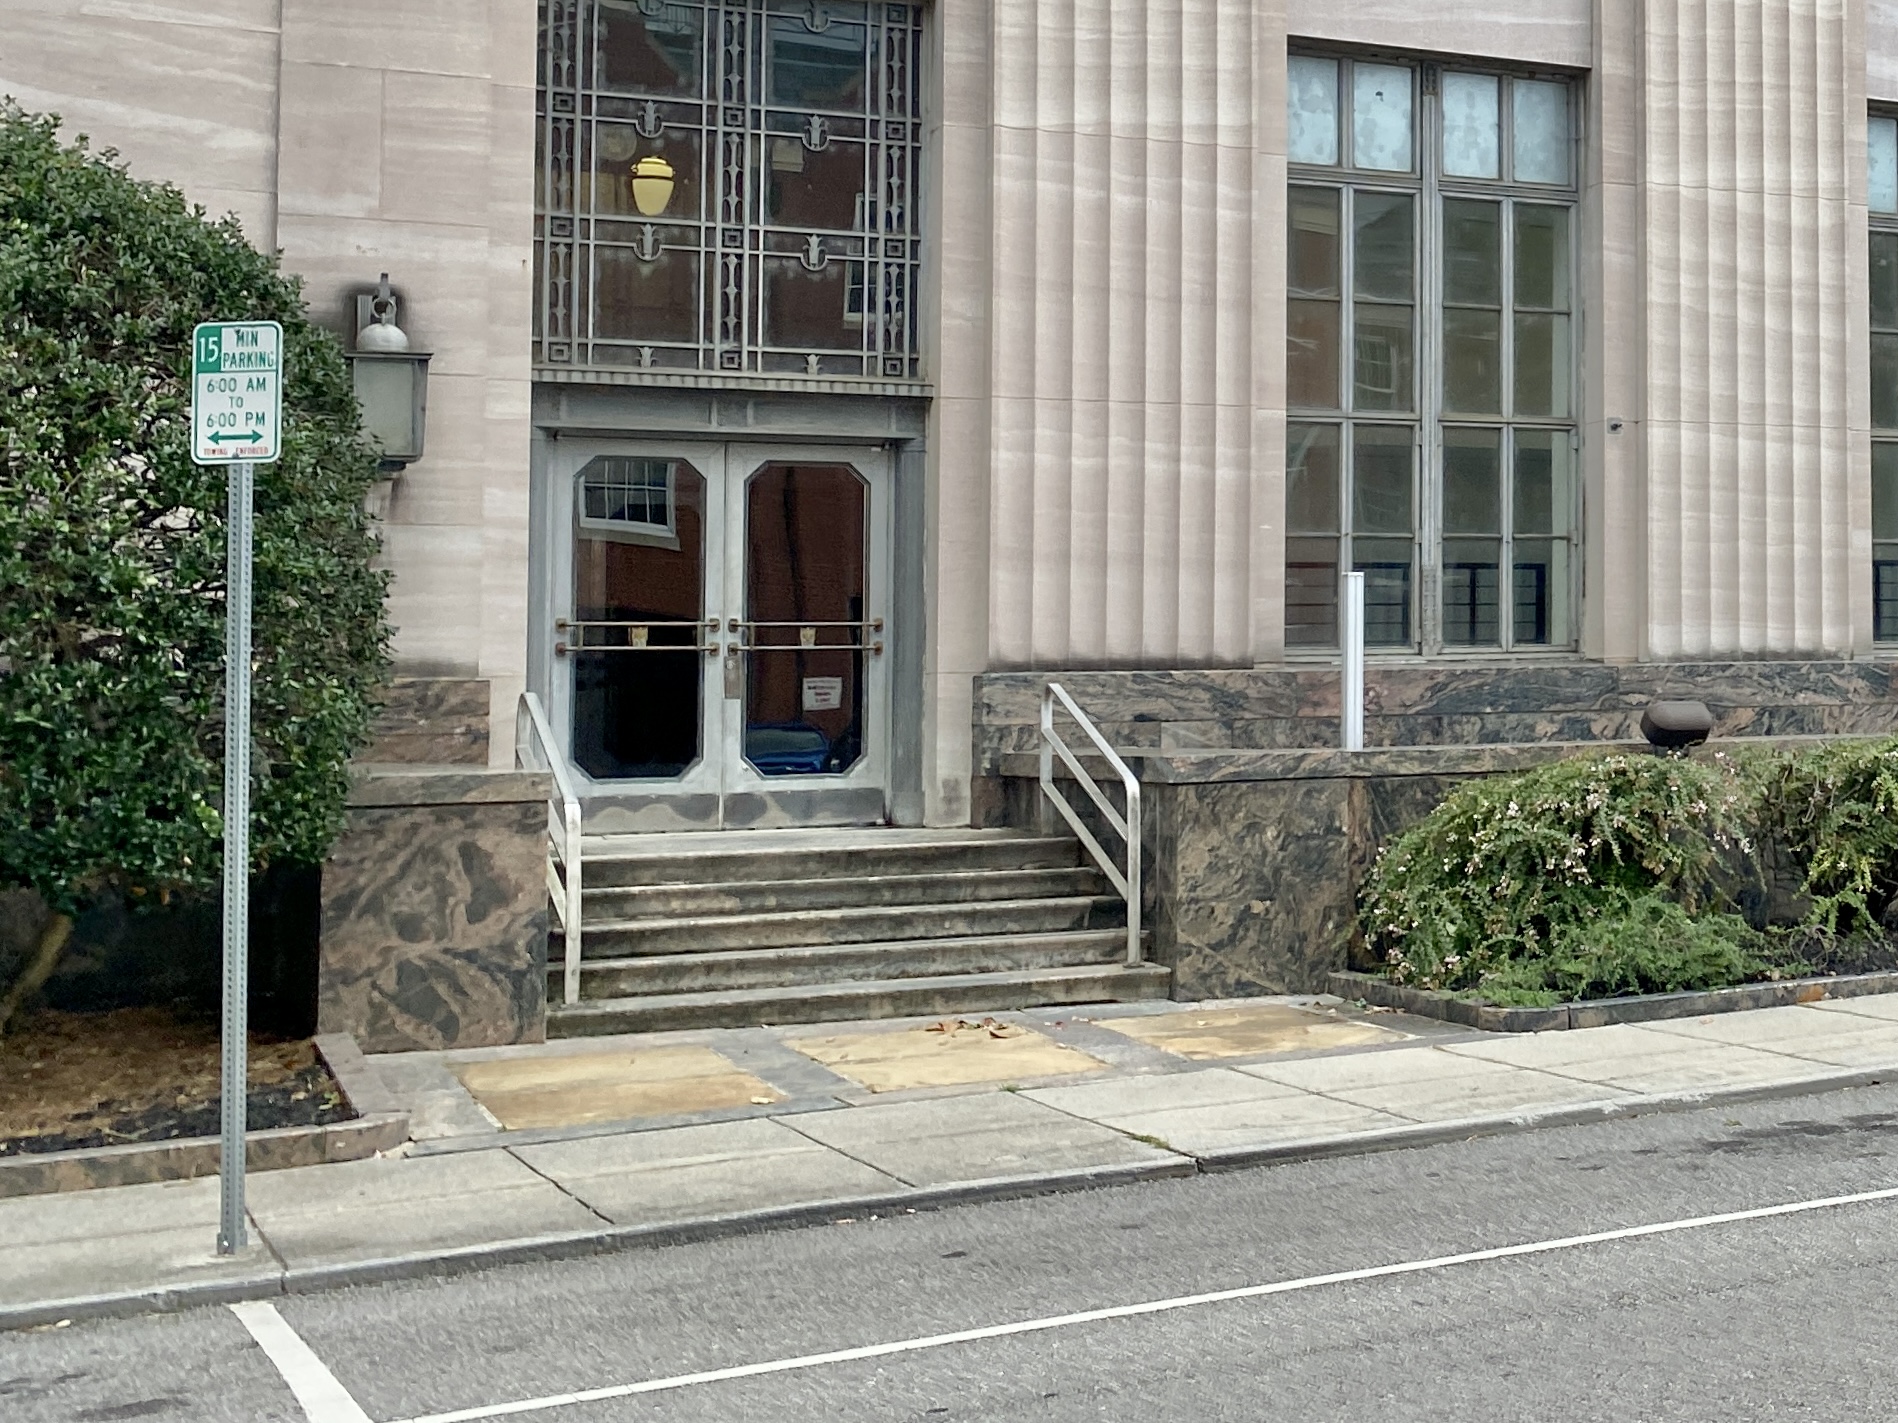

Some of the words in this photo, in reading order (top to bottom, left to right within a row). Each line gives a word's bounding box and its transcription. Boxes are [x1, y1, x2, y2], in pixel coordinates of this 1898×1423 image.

[235, 330, 259, 348] MIN
[199, 336, 219, 363] 15
[223, 351, 275, 369] PARKING
[206, 377, 237, 393] 6:00
[246, 377, 267, 392] AM
[229, 396, 244, 409] TO
[206, 413, 237, 428] 6:00
[245, 411, 266, 427] PM
